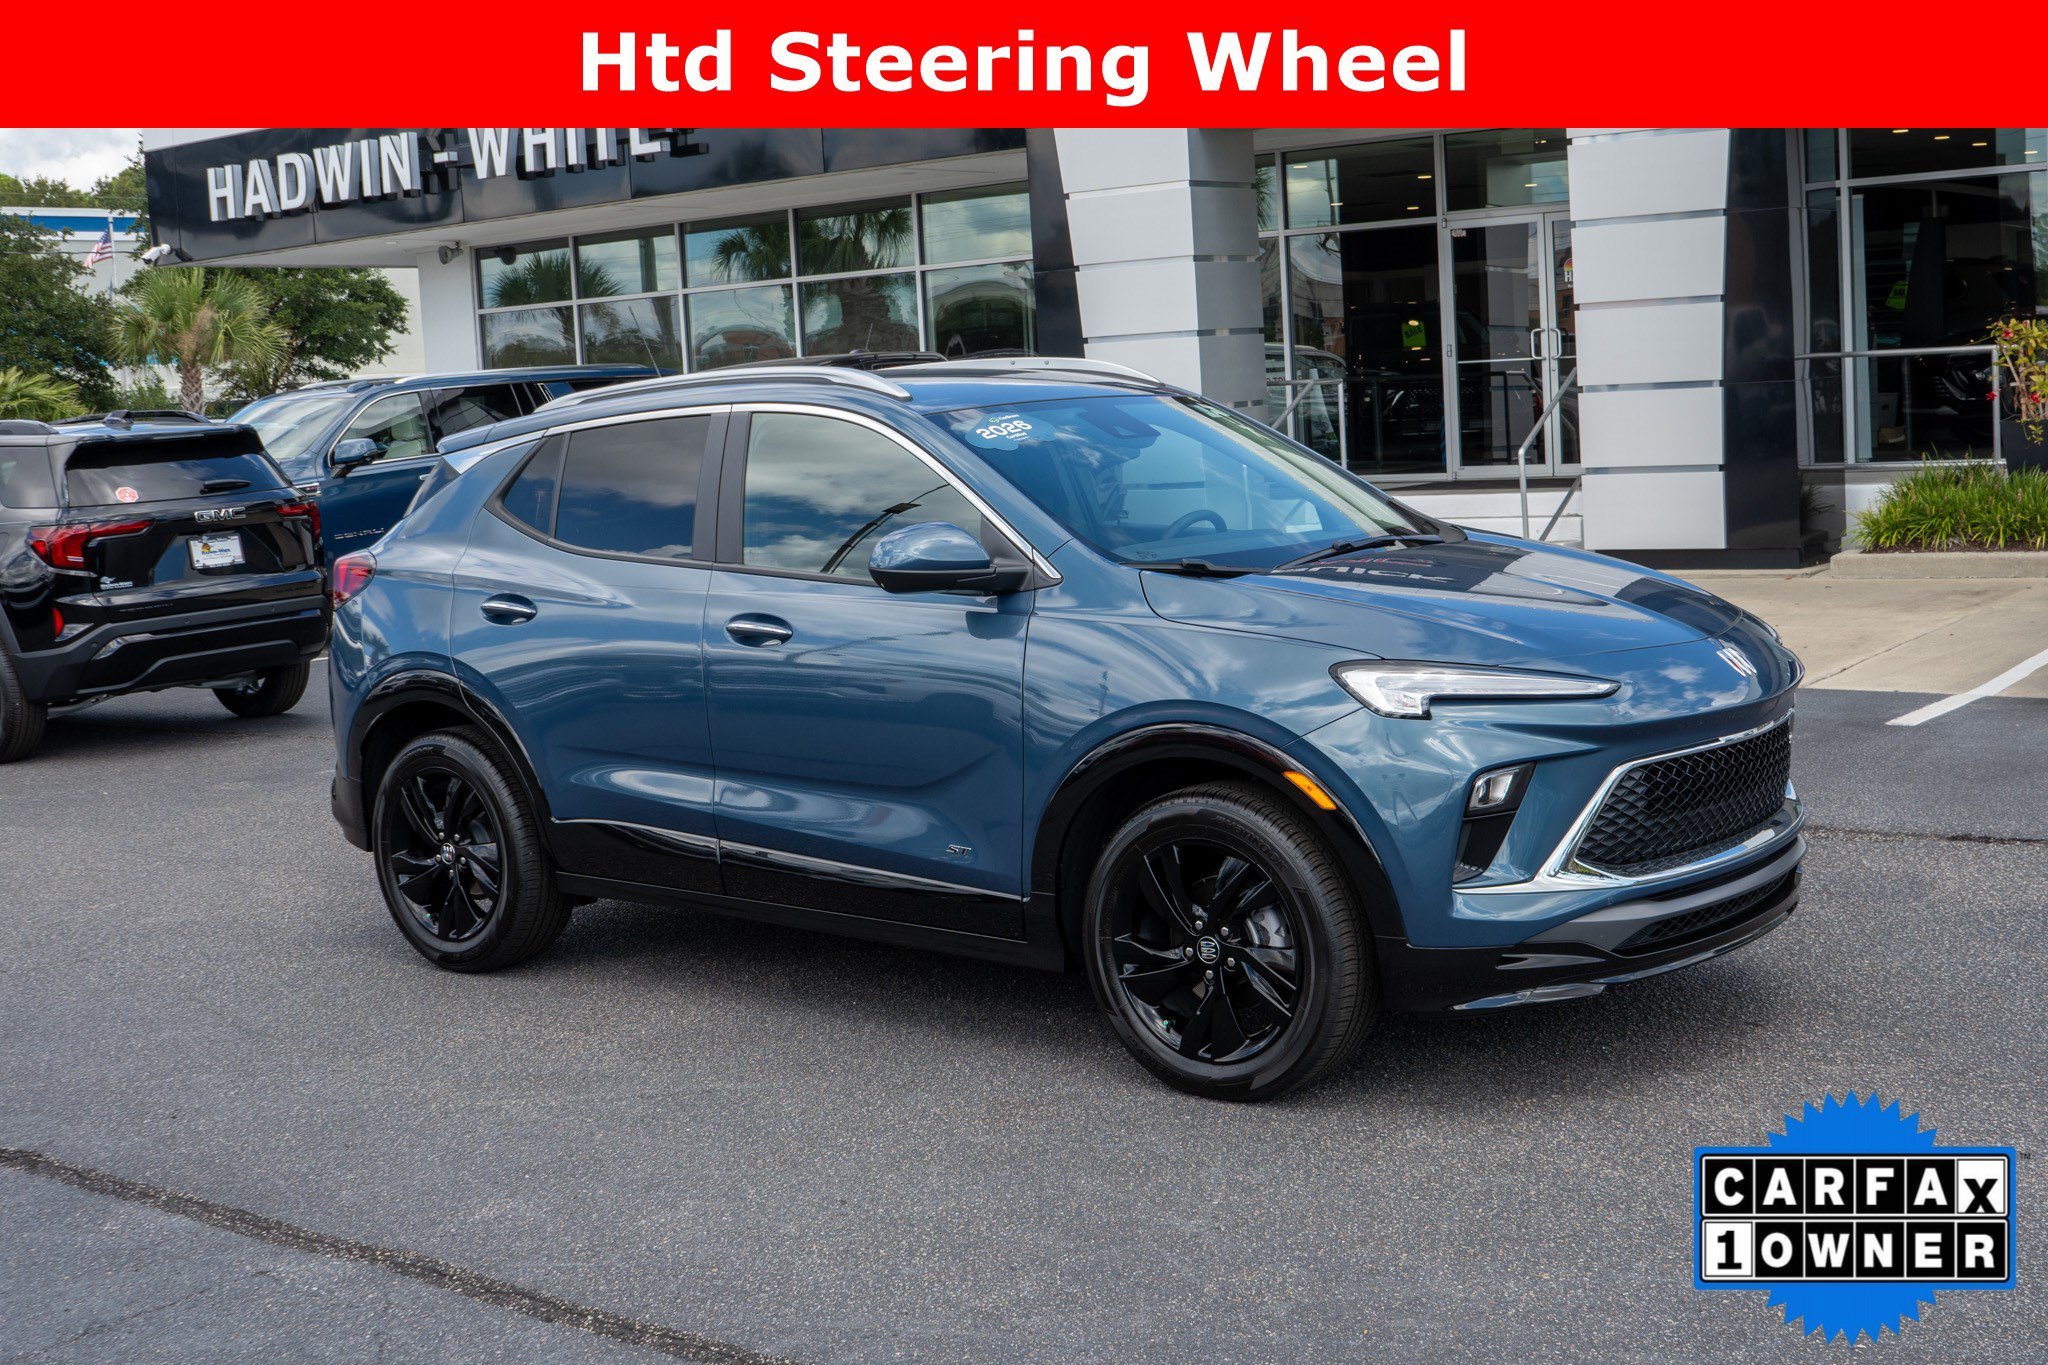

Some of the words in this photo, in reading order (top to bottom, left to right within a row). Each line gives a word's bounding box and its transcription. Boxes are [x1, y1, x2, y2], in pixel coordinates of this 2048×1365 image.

[206, 130, 421, 222] HADWIN
[976, 420, 1032, 440] 2026
[194, 506, 247, 523] GMC
[945, 844, 972, 857] ST
